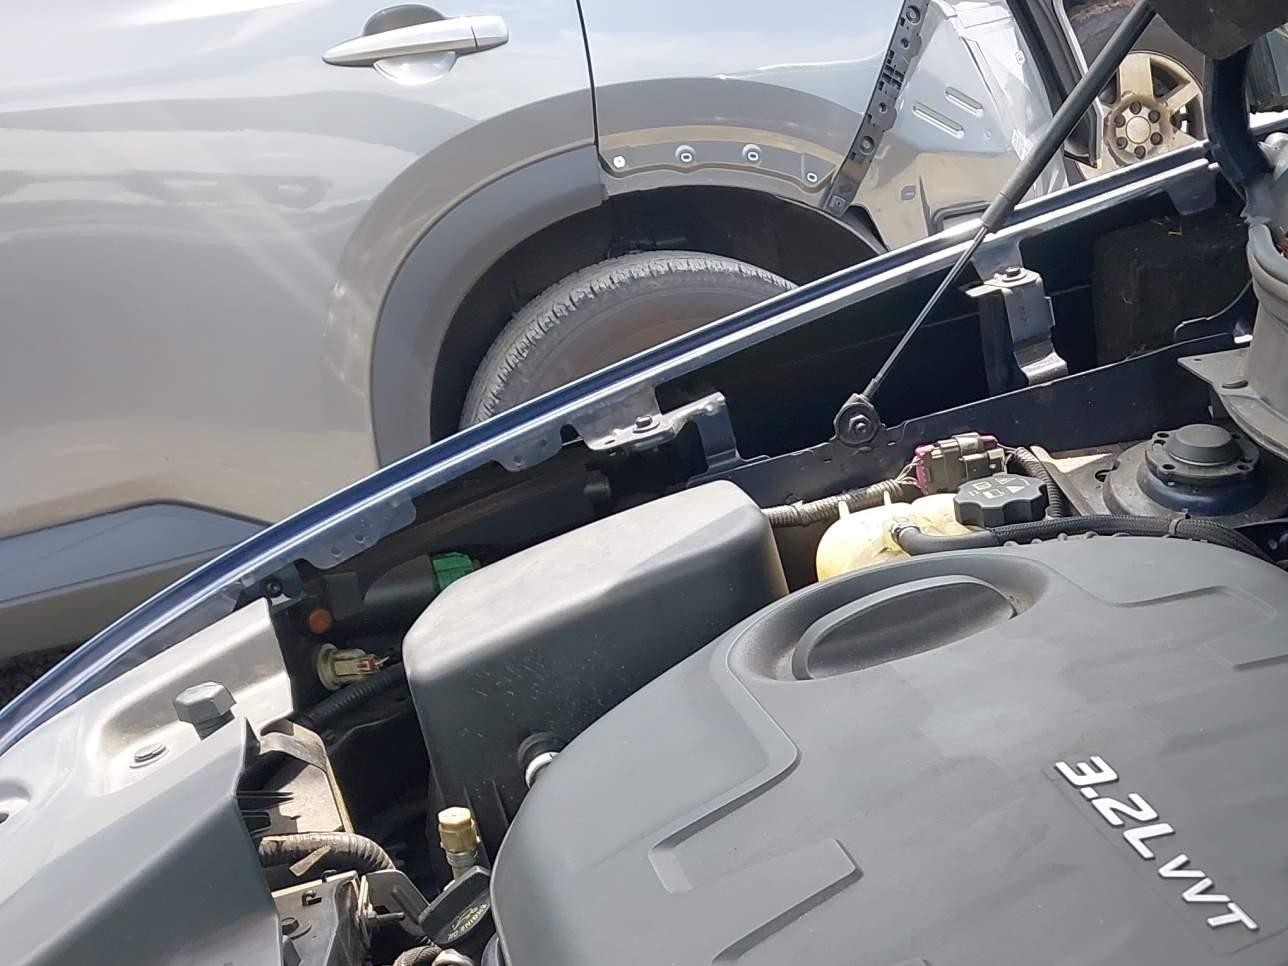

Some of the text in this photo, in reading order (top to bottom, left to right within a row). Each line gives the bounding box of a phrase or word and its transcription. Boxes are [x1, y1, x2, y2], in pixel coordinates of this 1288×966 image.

[1054, 756, 1259, 931] 3.2L VVT
[461, 904, 487, 931] ENGINE
